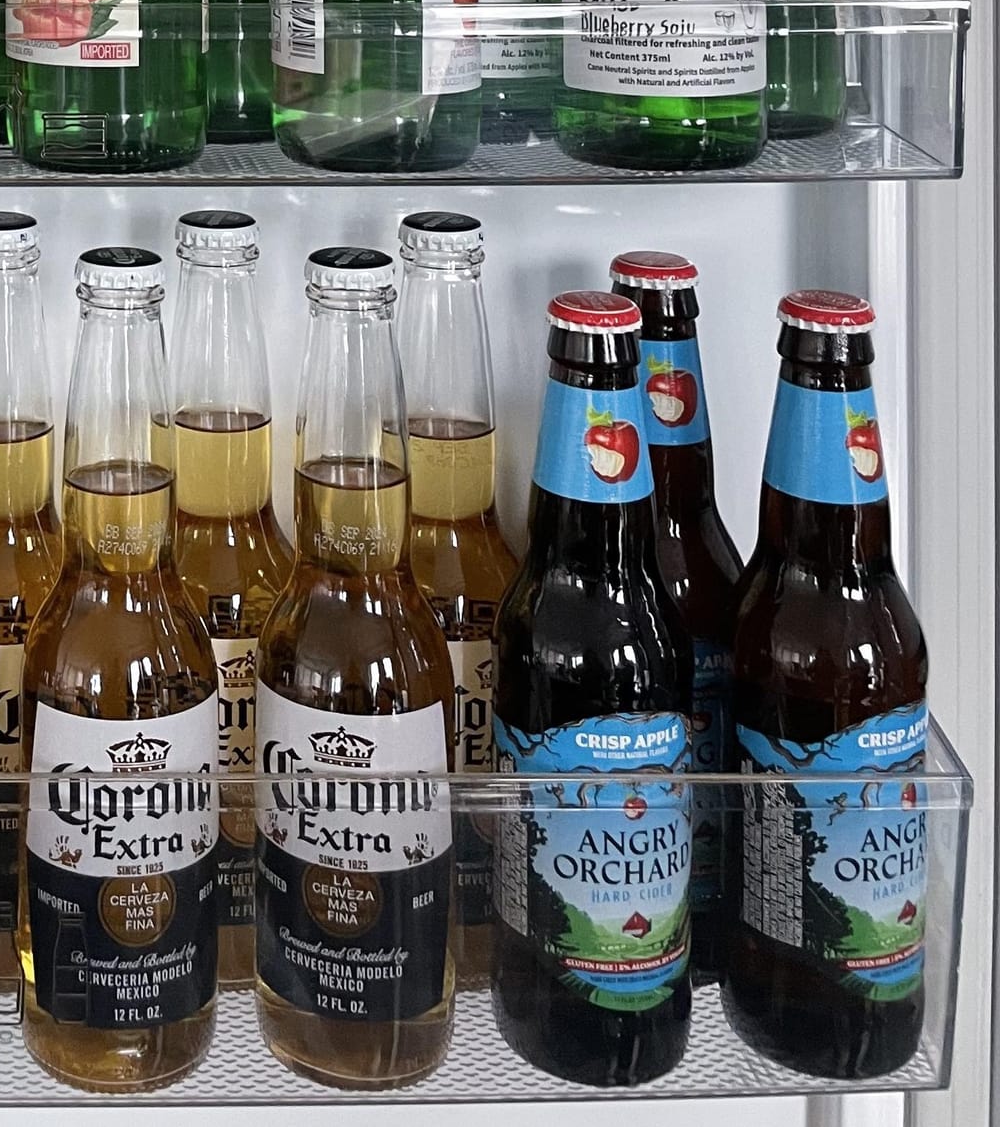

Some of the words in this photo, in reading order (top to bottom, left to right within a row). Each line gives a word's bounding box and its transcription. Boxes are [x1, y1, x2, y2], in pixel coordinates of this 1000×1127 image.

[580, 11, 655, 37] Blueberry
[660, 19, 697, 36] Soju
[615, 35, 648, 48] filtered
[650, 38, 664, 49] for
[665, 38, 711, 51] refreshing
[712, 37, 727, 48] and
[82, 44, 130, 62] IMPORTED
[501, 48, 516, 59] Alc.
[517, 48, 534, 59] 12%
[589, 49, 602, 61] Net
[604, 51, 640, 62] Content
[641, 53, 671, 64] 375ml
[702, 53, 718, 63] Alc.
[719, 52, 735, 62] 12%
[587, 63, 603, 72] Cane
[604, 64, 631, 75] Neutral
[631, 66, 657, 78] Spirits
[658, 67, 672, 76] and
[673, 66, 698, 78] Spirits
[618, 77, 636, 86] with
[636, 78, 665, 87] Natural
[665, 78, 681, 87] and
[681, 77, 712, 87] Artificial
[574, 731, 630, 750] CRISP
[632, 724, 679, 748] APPLE
[857, 728, 904, 749] CRISP
[296, 811, 392, 853] Extra
[576, 818, 680, 856] ANGRY
[91, 824, 184, 861] Extra
[318, 853, 347, 868] SINCE
[552, 841, 691, 886] ORCHARD
[116, 864, 143, 877] SINCE
[130, 881, 147, 894] LA
[333, 873, 351, 887] LA
[108, 891, 169, 907] CERVEZA
[312, 881, 375, 902] CERVEZA
[411, 890, 435, 910] BEER
[590, 888, 630, 904] HARD
[638, 882, 674, 900] CIDER
[871, 880, 904, 902] HARD
[36, 888, 81, 914] IMPORTED
[327, 898, 358, 913] MAS
[125, 906, 154, 919] MAS
[327, 911, 358, 926] FINA
[125, 918, 155, 931] FINA
[279, 925, 319, 955] Brewed
[320, 944, 346, 961] and
[347, 945, 392, 964] Bottled
[392, 947, 409, 966] by
[117, 955, 141, 970] and
[142, 947, 182, 969] Bottled
[284, 946, 354, 980] CERVECERIA
[356, 965, 403, 980] MODELO
[565, 957, 593, 970] GLUTEN
[151, 960, 193, 984] MODELO
[318, 972, 364, 993] MEXICO
[115, 985, 160, 1000] MEXICO
[315, 994, 328, 1008] 12
[330, 996, 347, 1012] FL.
[350, 999, 368, 1015] OZ.
[113, 1009, 126, 1022] 12
